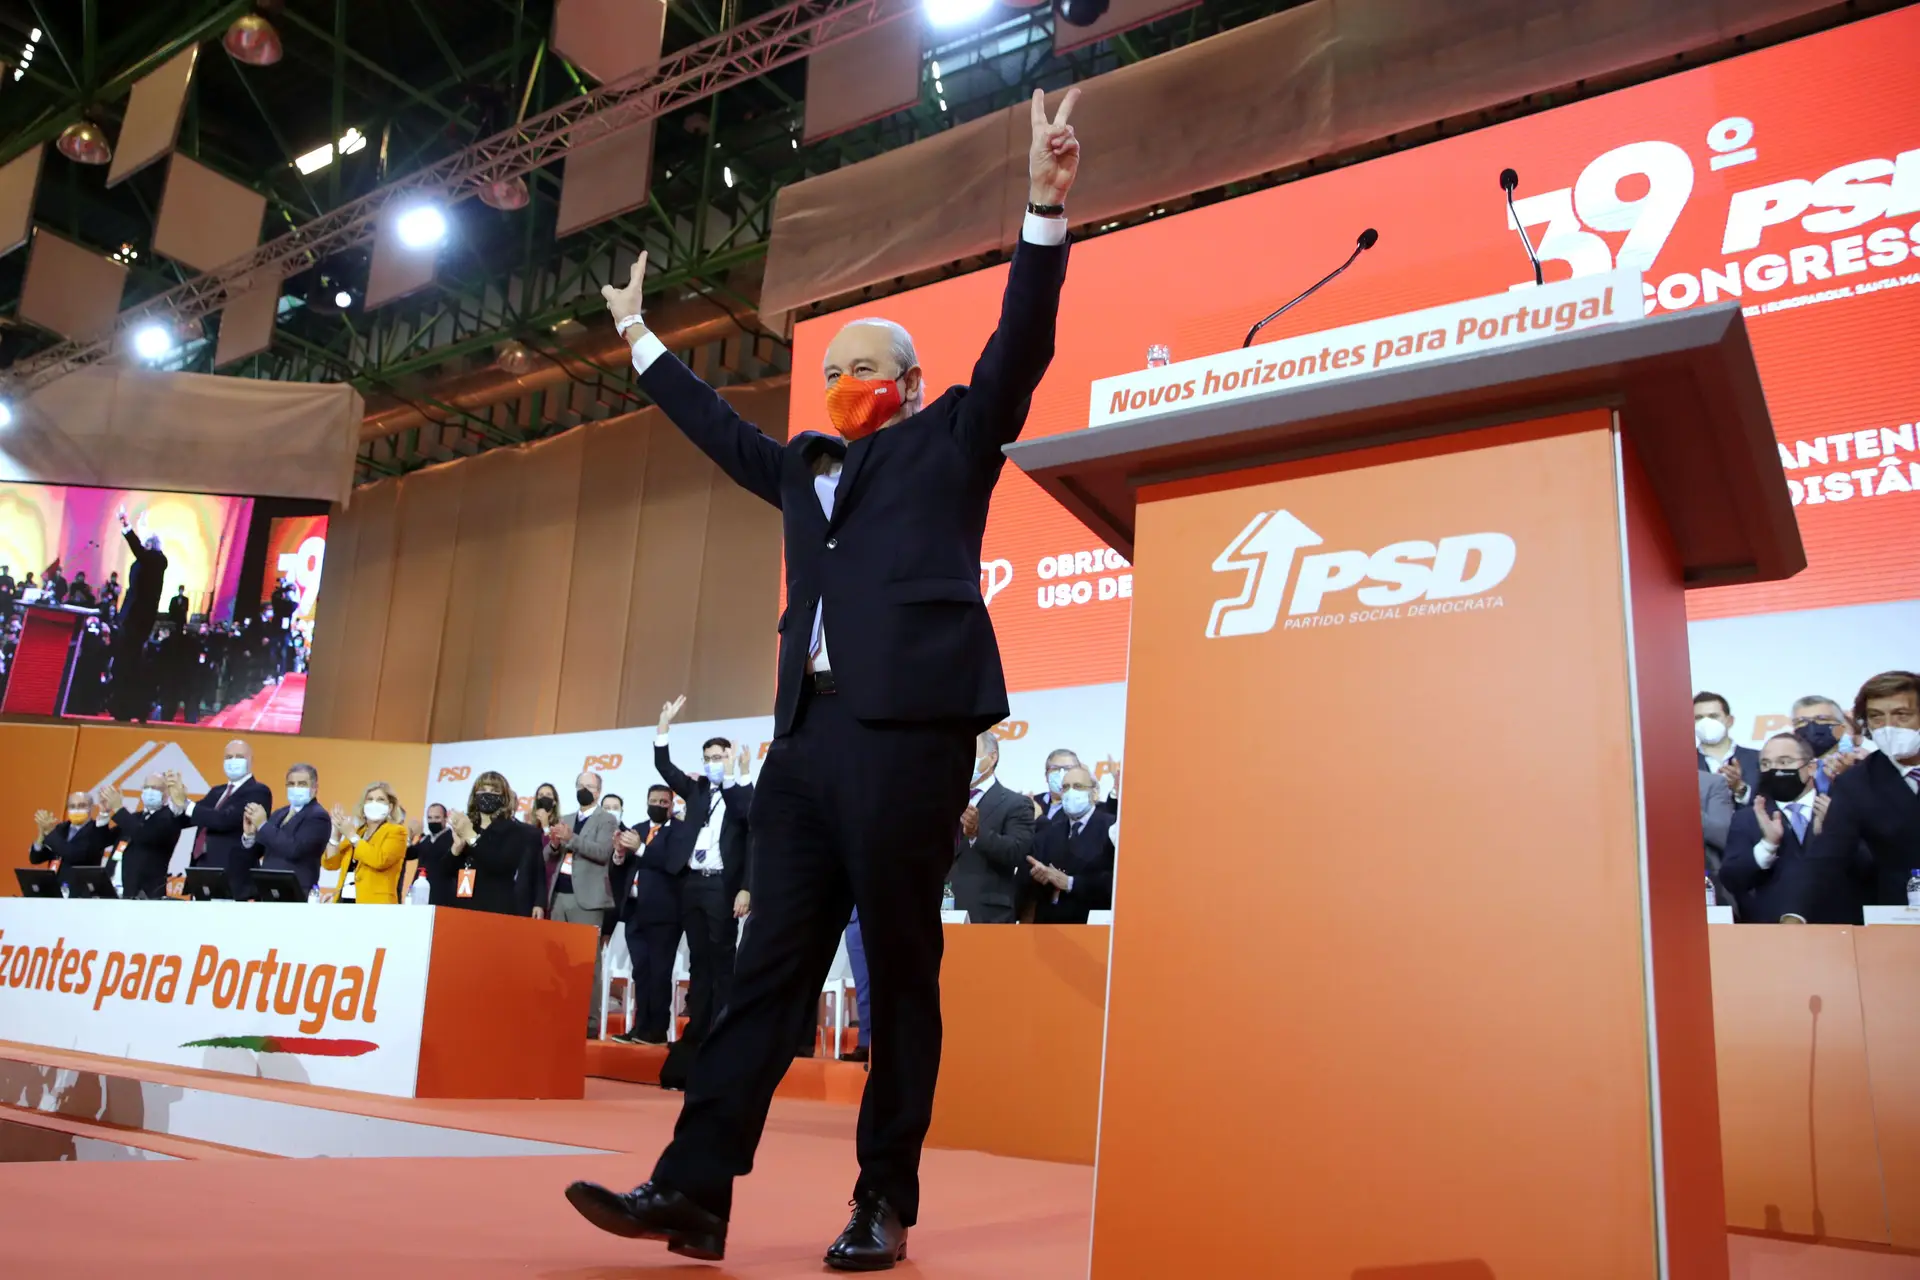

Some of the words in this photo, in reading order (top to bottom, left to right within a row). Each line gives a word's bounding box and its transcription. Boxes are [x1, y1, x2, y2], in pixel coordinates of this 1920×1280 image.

[1109, 380, 1195, 414] Novos
[1202, 345, 1365, 396] horizontes
[1373, 330, 1447, 367] para
[1456, 287, 1614, 344] Portugal
[1777, 422, 1920, 469] ANTEN
[1037, 548, 1131, 580] OBRIG
[1289, 532, 1518, 617] PSD
[1037, 581, 1093, 609] USO
[1098, 574, 1133, 601] DE
[1283, 612, 1345, 630] PARTIDO
[1349, 608, 1402, 624] SOCIAL
[1407, 595, 1505, 617] DEMOCRATA
[988, 720, 1029, 742] SD
[437, 765, 472, 783] PSD
[582, 753, 623, 773] PSD
[0, 929, 98, 995] zontes
[92, 950, 183, 1012] para
[185, 943, 387, 1035] Portugal
